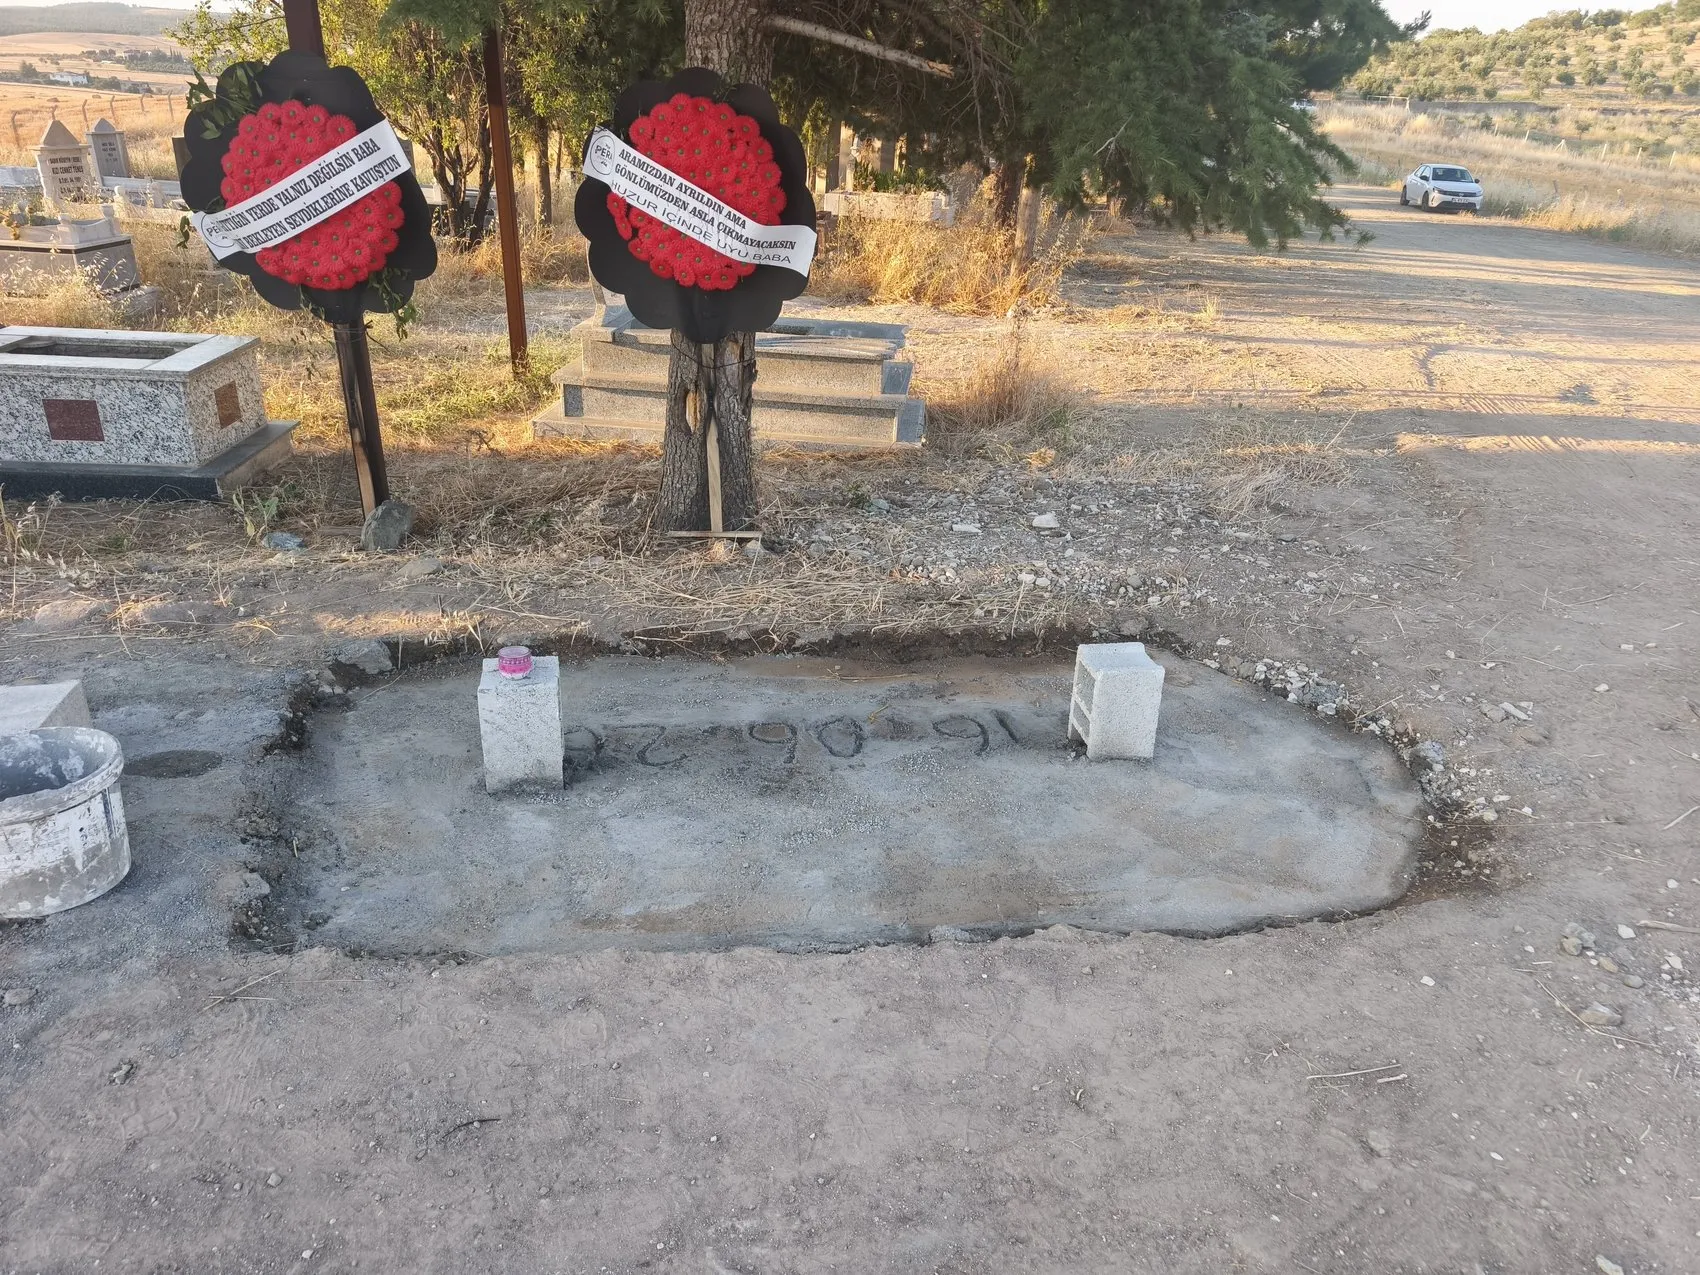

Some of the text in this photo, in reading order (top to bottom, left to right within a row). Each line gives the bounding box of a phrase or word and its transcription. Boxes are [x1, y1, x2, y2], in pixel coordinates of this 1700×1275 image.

[242, 220, 289, 249] BEKLEYEN
[284, 182, 356, 230] SEVDİKLERİNE
[350, 154, 402, 193] KAVUŞTUN
[245, 198, 280, 222] YERDE
[274, 178, 313, 207] YALNIZ
[307, 151, 356, 189] DEĞİLSİN
[351, 138, 381, 162] BABA
[611, 180, 792, 264] HUZUR İÇİNDE UYU BABA
[614, 163, 797, 250] GÖNLÜMÜZDEN ASLA ÇIKMAYACAKSIN
[618, 148, 747, 230] ARAMIZDAN AYRILDIN AMA
